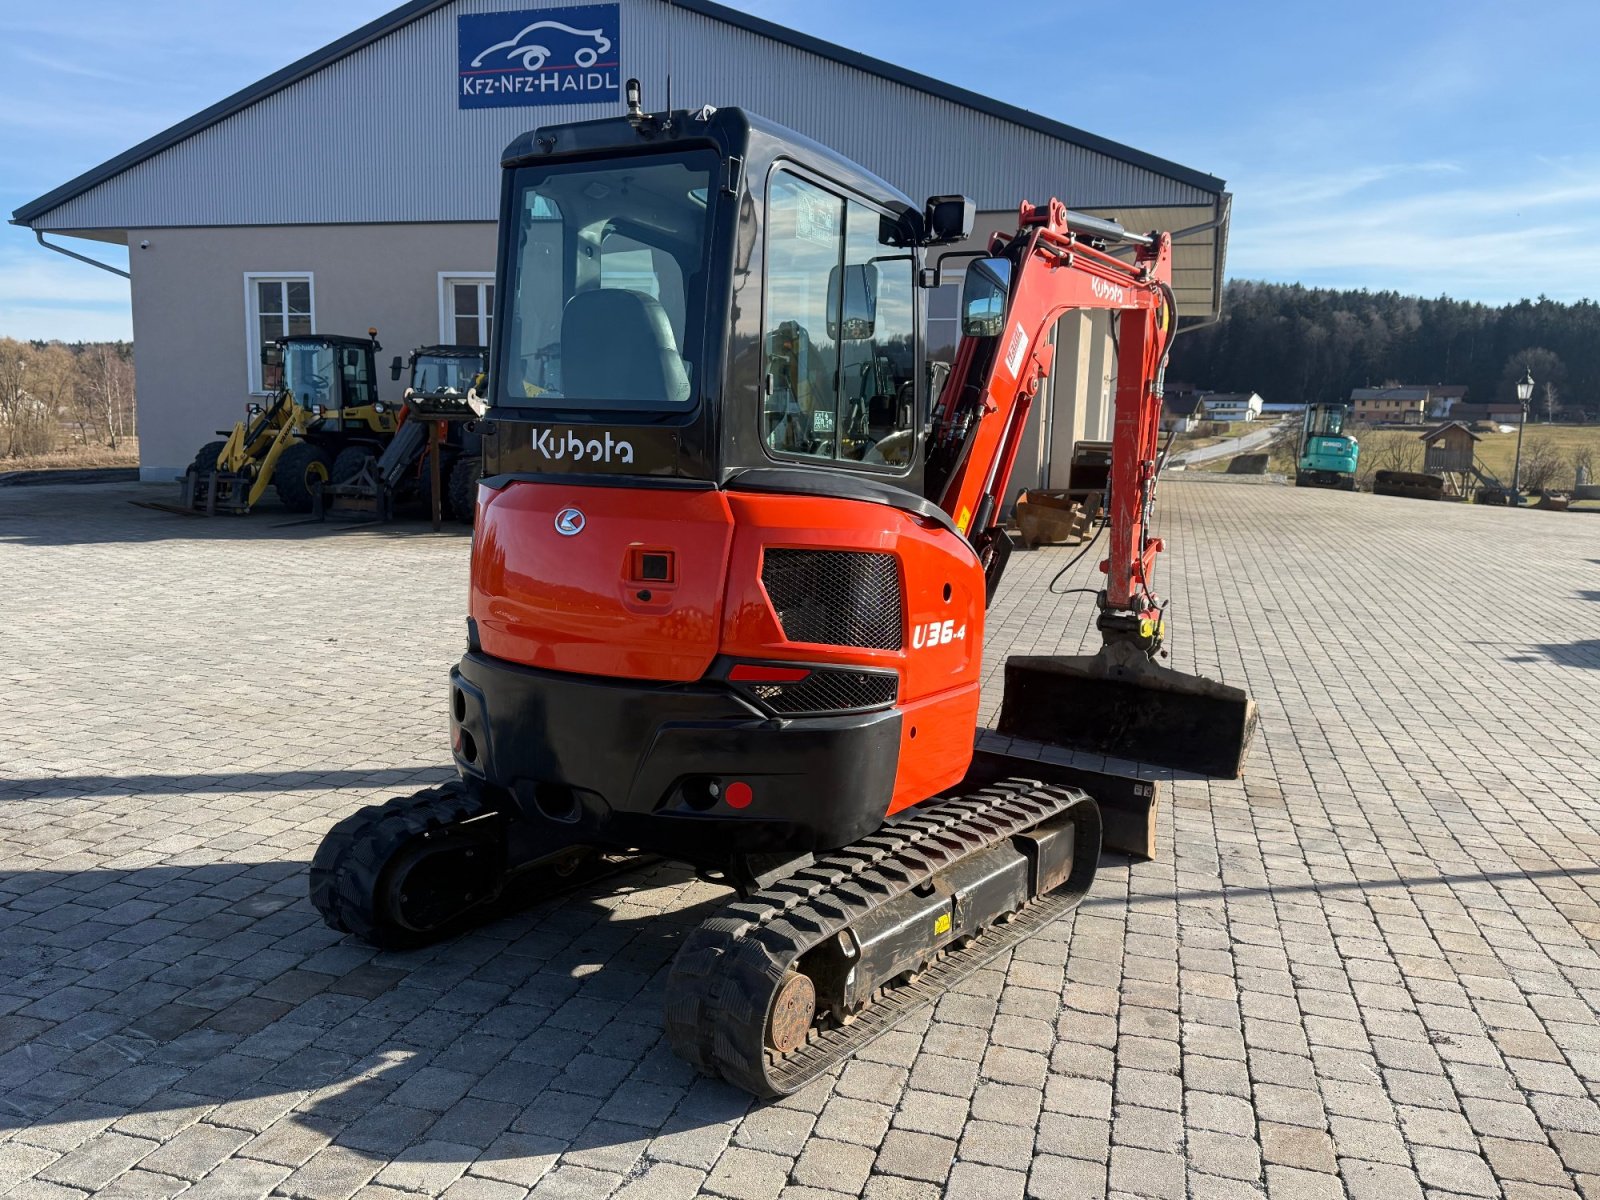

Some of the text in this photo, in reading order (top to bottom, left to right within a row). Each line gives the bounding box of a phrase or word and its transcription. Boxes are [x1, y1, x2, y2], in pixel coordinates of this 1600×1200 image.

[1091, 275, 1123, 304] Kubota
[532, 428, 634, 464] Kubota
[912, 619, 966, 650] U36-4
